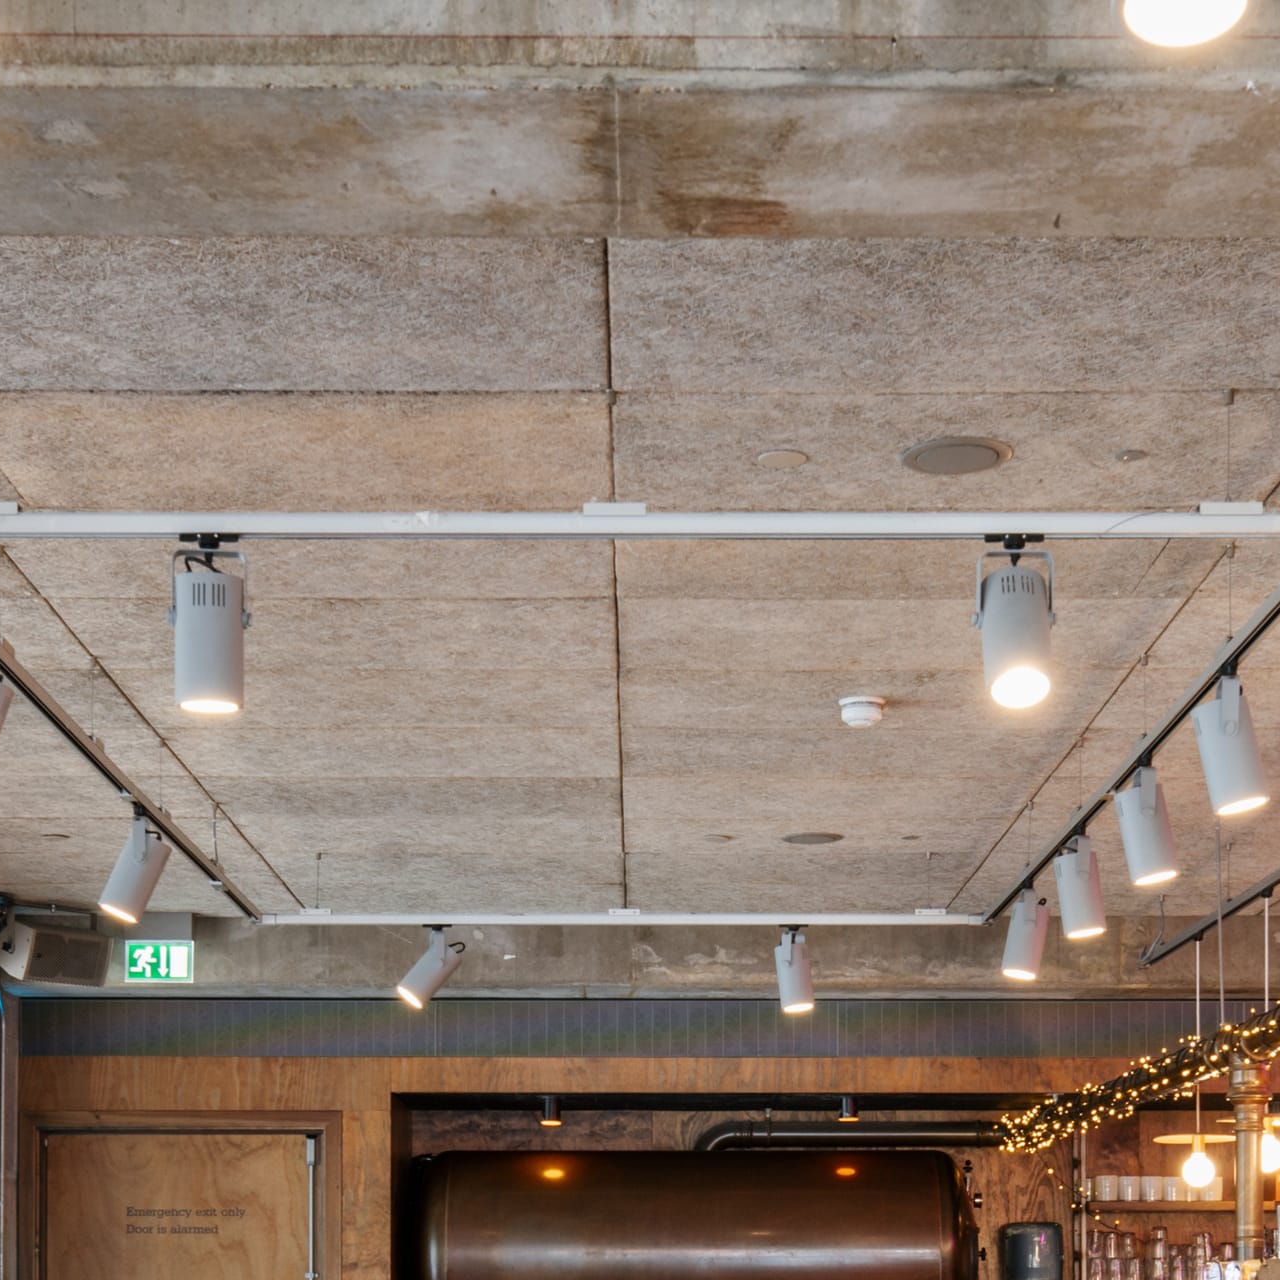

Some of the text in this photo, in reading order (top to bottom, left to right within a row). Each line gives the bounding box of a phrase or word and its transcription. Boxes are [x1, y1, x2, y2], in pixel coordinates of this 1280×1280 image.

[126, 1206, 246, 1219] Emergency exit only
[126, 1224, 219, 1234] Door is alarmed
